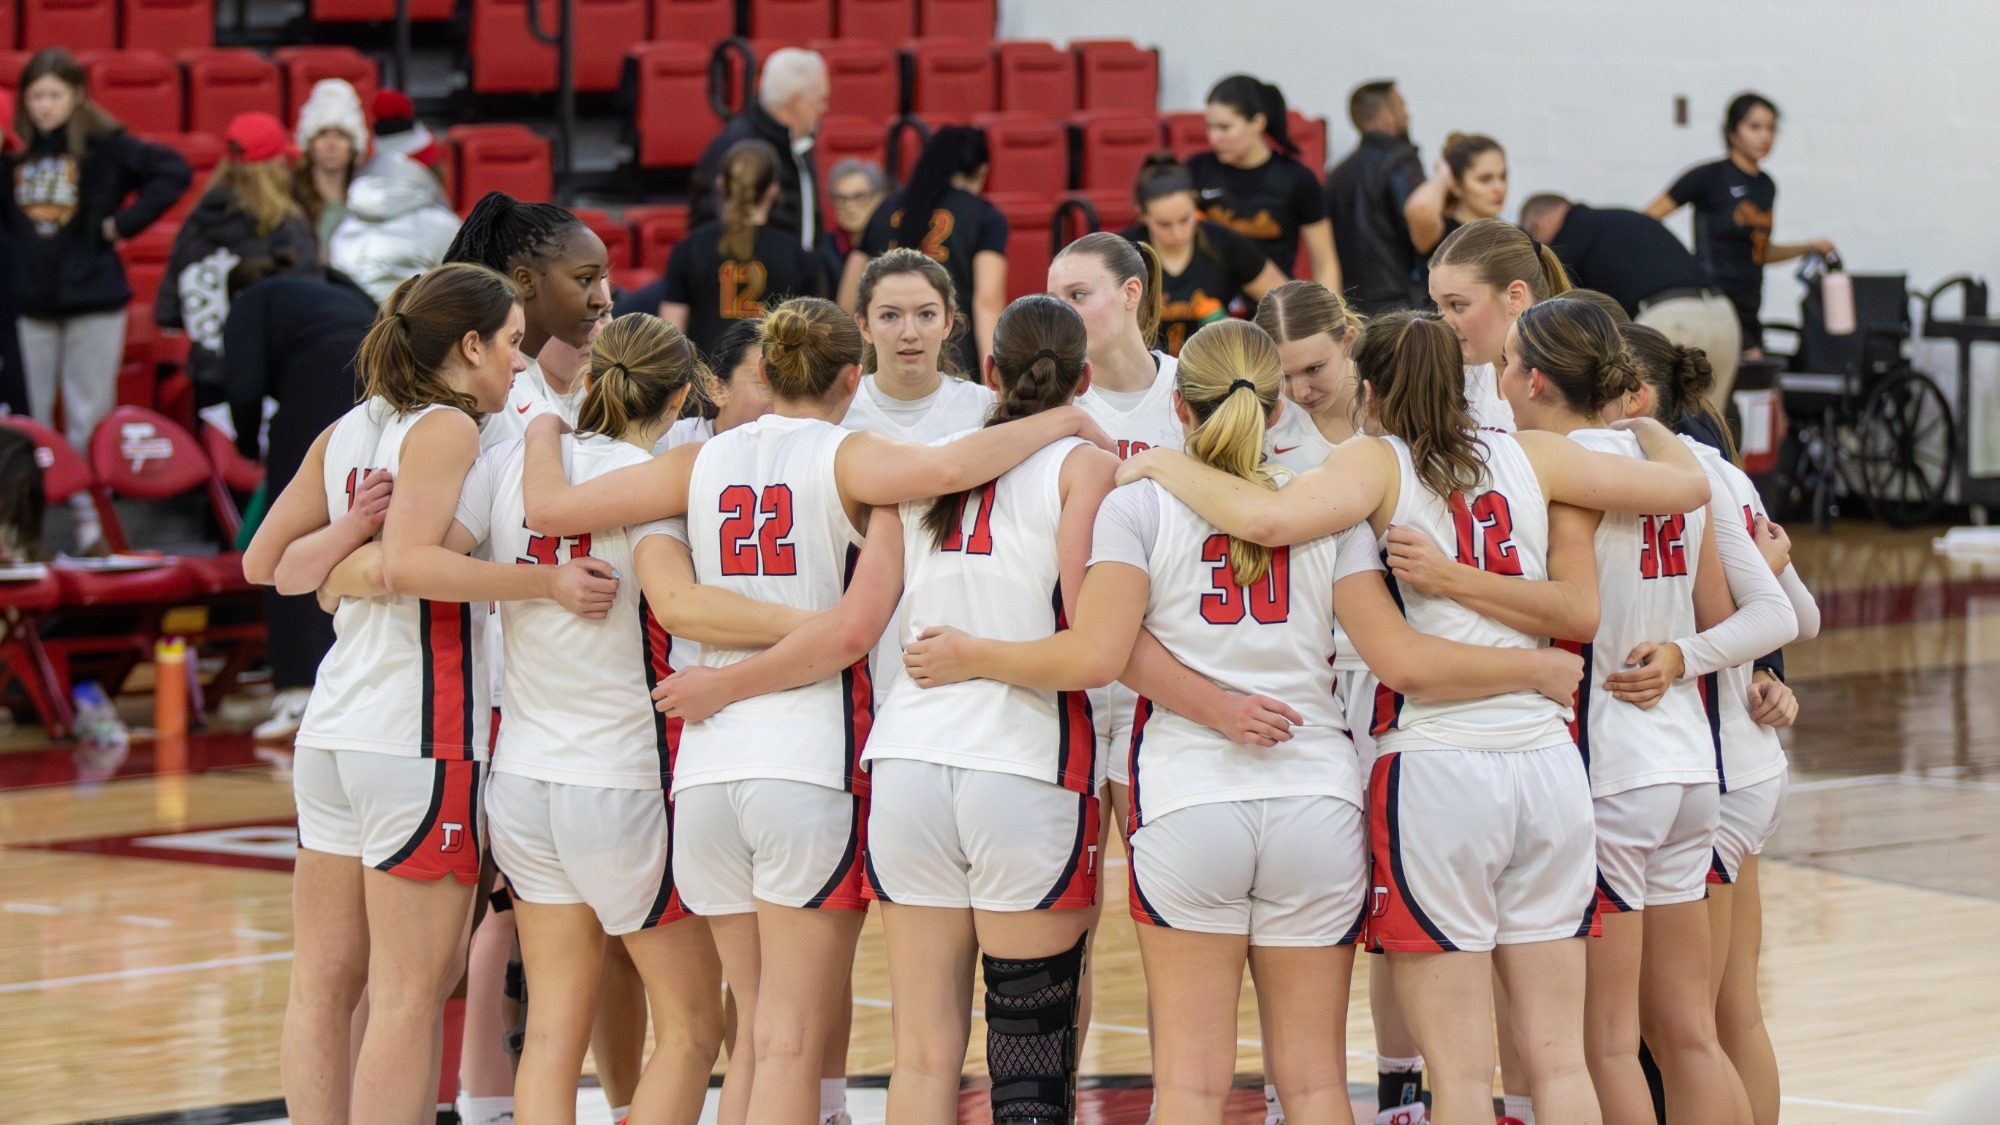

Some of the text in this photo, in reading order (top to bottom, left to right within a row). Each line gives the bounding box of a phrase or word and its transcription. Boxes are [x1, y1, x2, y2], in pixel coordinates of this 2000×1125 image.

[889, 207, 955, 263] 2
[719, 483, 797, 576] 22
[1447, 488, 1524, 576] 12
[1200, 533, 1290, 625] 30
[440, 821, 465, 853] D
